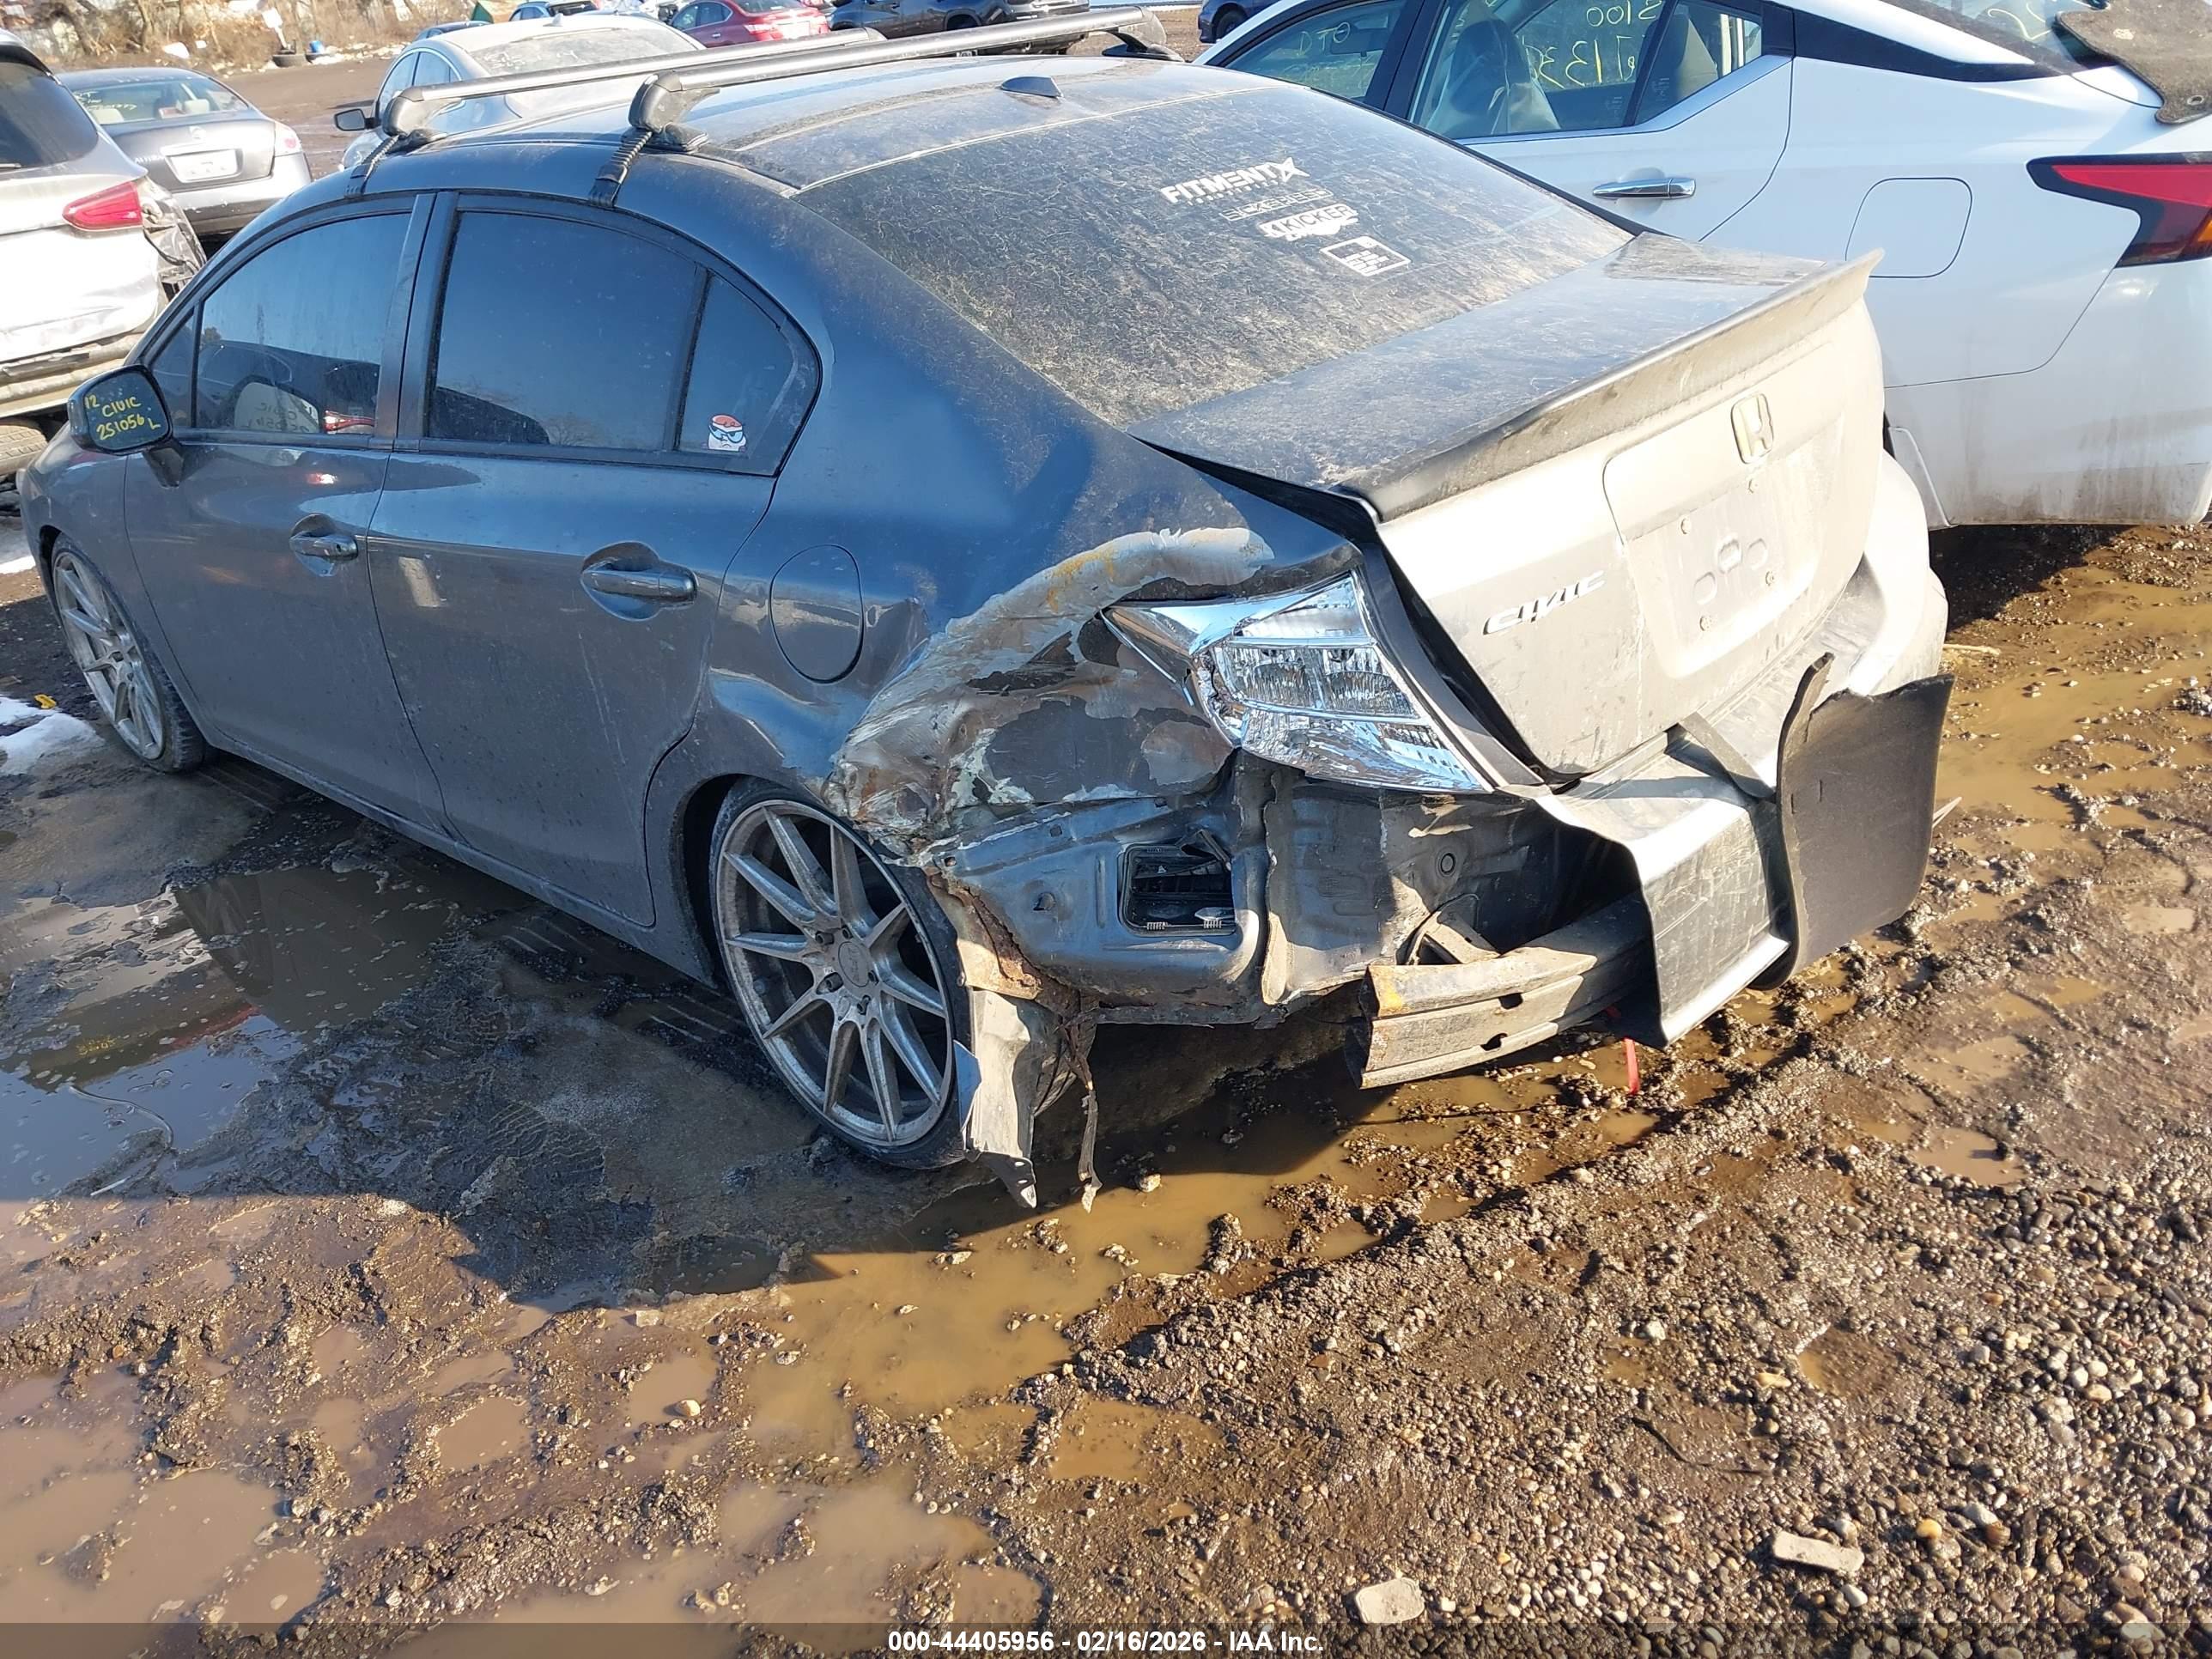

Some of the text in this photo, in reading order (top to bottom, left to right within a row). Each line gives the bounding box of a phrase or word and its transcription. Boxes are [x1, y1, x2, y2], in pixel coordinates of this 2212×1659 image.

[1160, 161, 1278, 204] FITMENT
[1279, 204, 1356, 233] KICKER
[84, 395, 100, 409] 12
[147, 417, 161, 430] L
[1483, 569, 1607, 635] CIVIC
